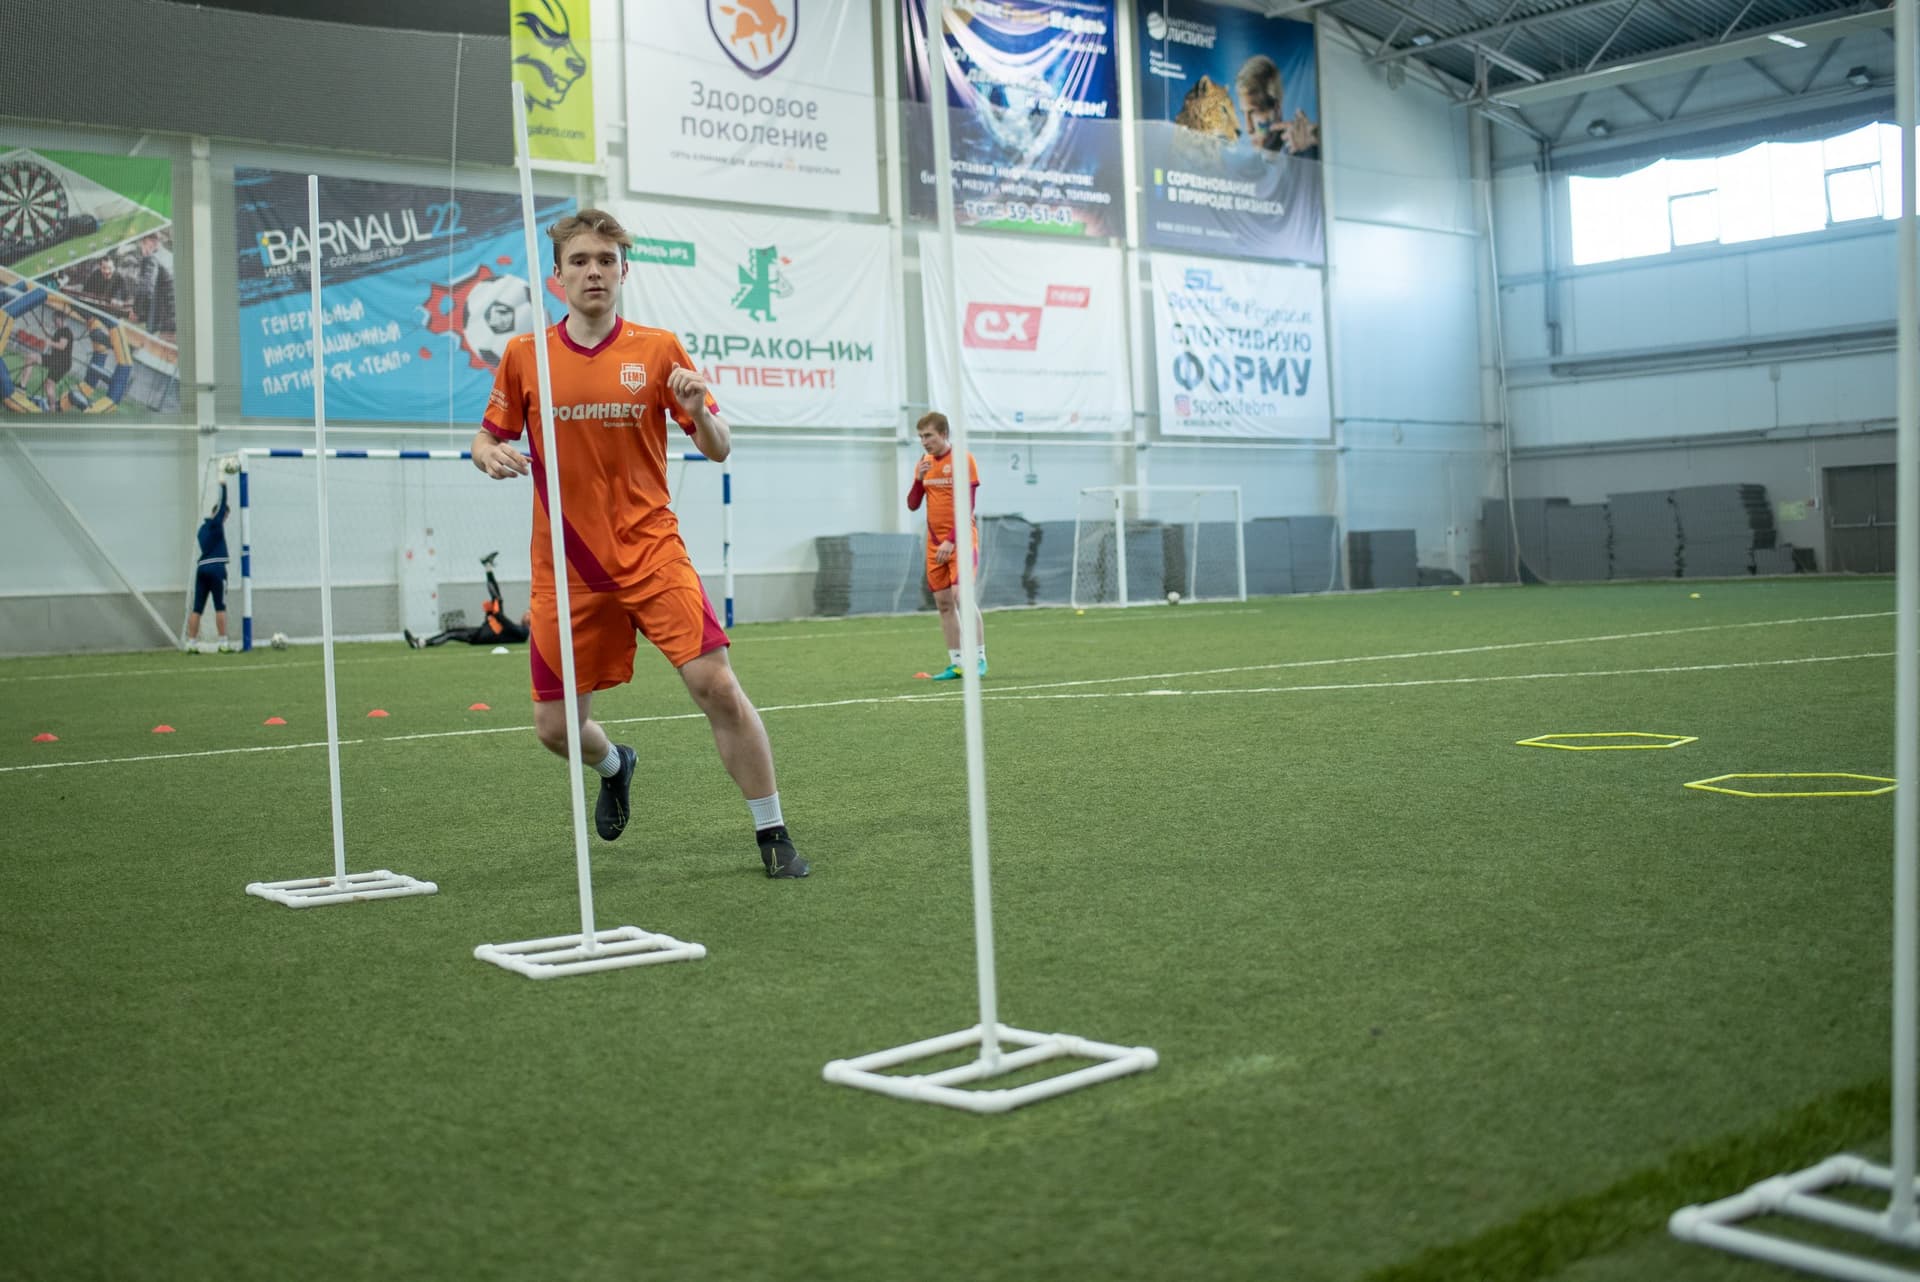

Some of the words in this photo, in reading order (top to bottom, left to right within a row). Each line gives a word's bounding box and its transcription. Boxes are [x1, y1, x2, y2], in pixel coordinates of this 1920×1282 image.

[689, 80, 819, 120] Здоровое
[681, 115, 829, 152] поколение
[261, 298, 365, 336] ГЕНЕРЬНЫЙ
[263, 320, 401, 368] ИНФОРАЦИОННЫЙ
[684, 332, 874, 362] ЗДРАКОНИМ
[331, 360, 356, 381] ФК
[622, 371, 645, 383] ТЕМП
[700, 364, 836, 390] АППЕТИТ!
[1173, 351, 1312, 396] ФОРМУ
[1010, 453, 1021, 471] 2
